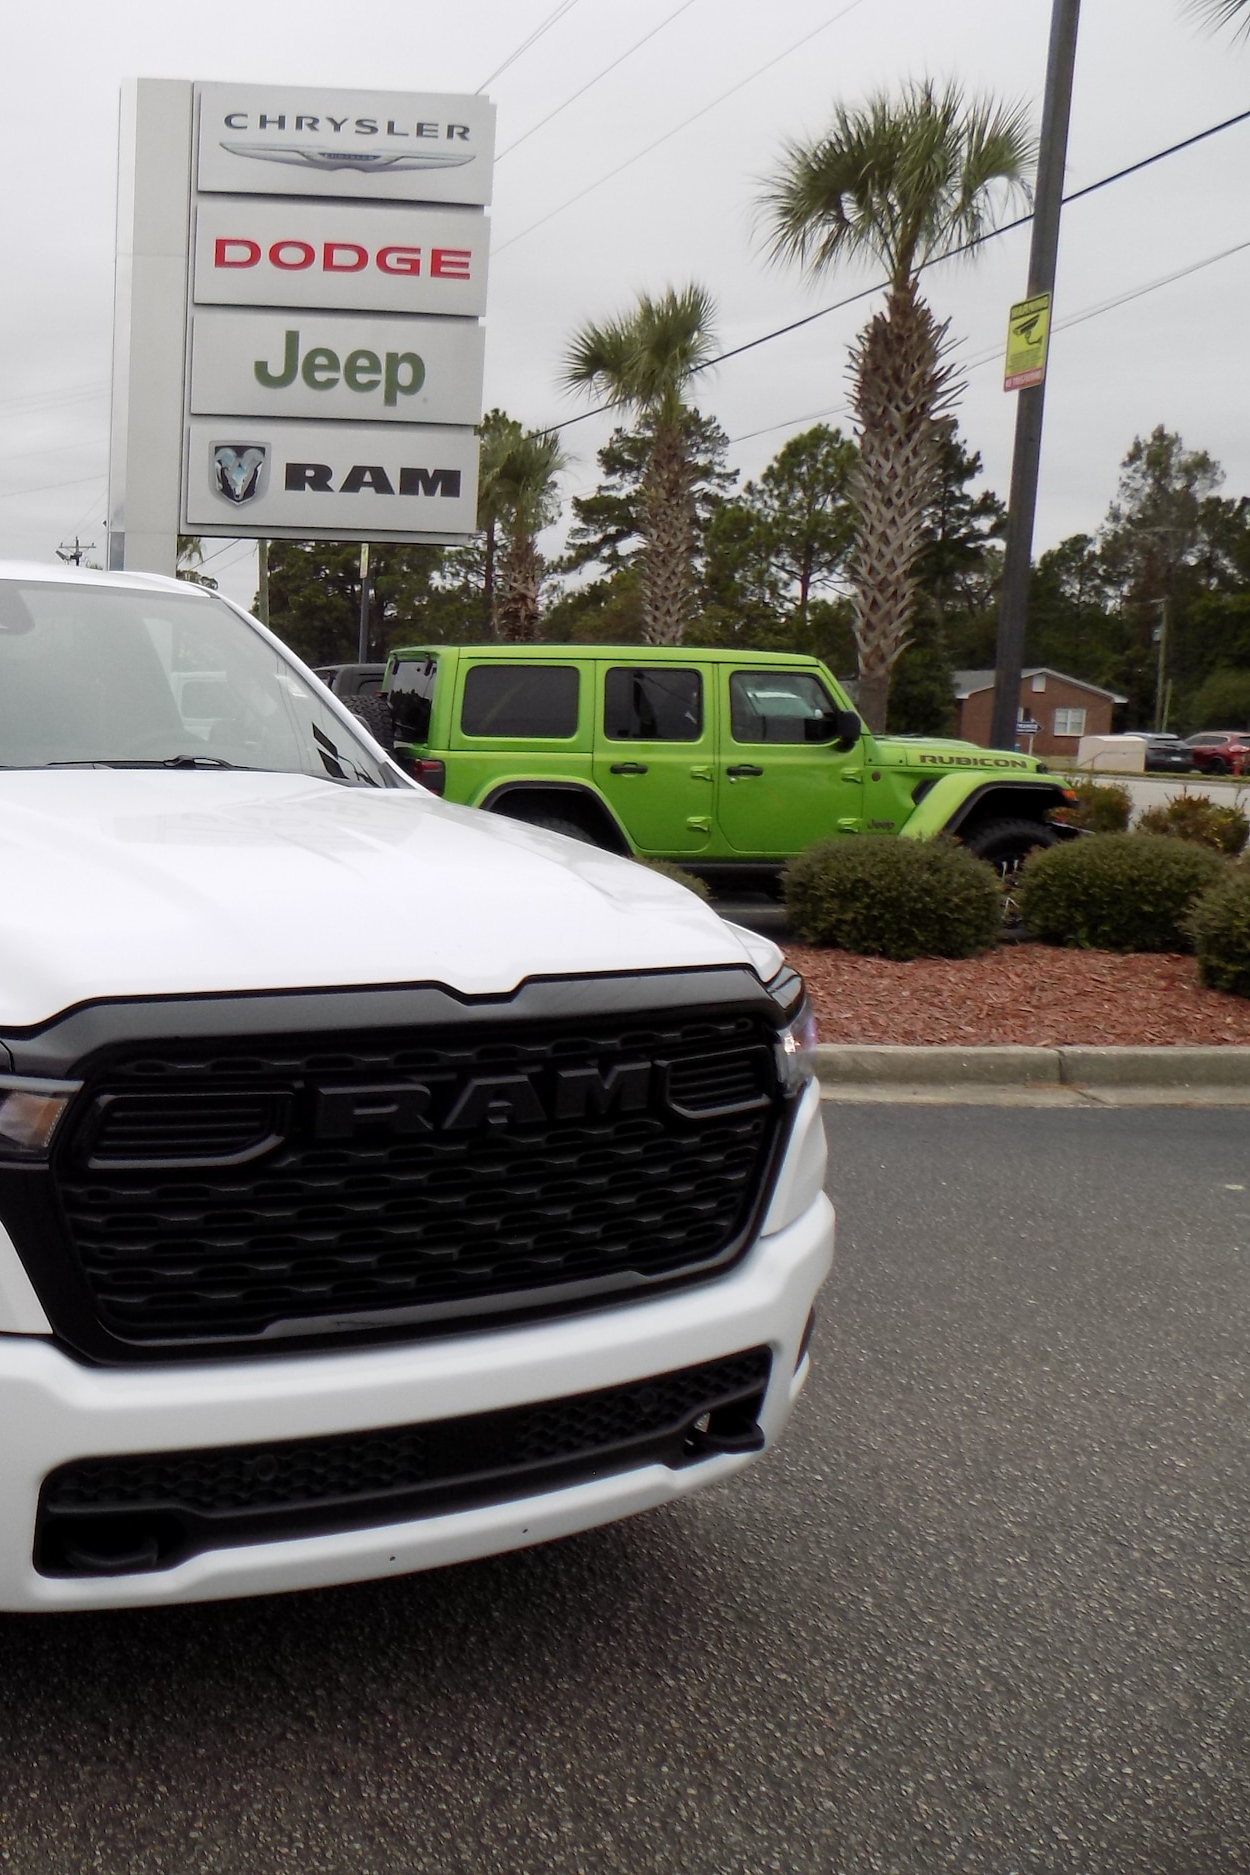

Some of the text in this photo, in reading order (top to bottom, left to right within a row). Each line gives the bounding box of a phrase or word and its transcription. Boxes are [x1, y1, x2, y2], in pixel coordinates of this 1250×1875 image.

[223, 112, 471, 142] CHRYSLER
[214, 238, 472, 281] DODGE
[253, 330, 426, 407] Jeep
[284, 462, 461, 498] RAM
[919, 754, 1028, 769] RUBICON
[315, 1060, 654, 1140] RAM
